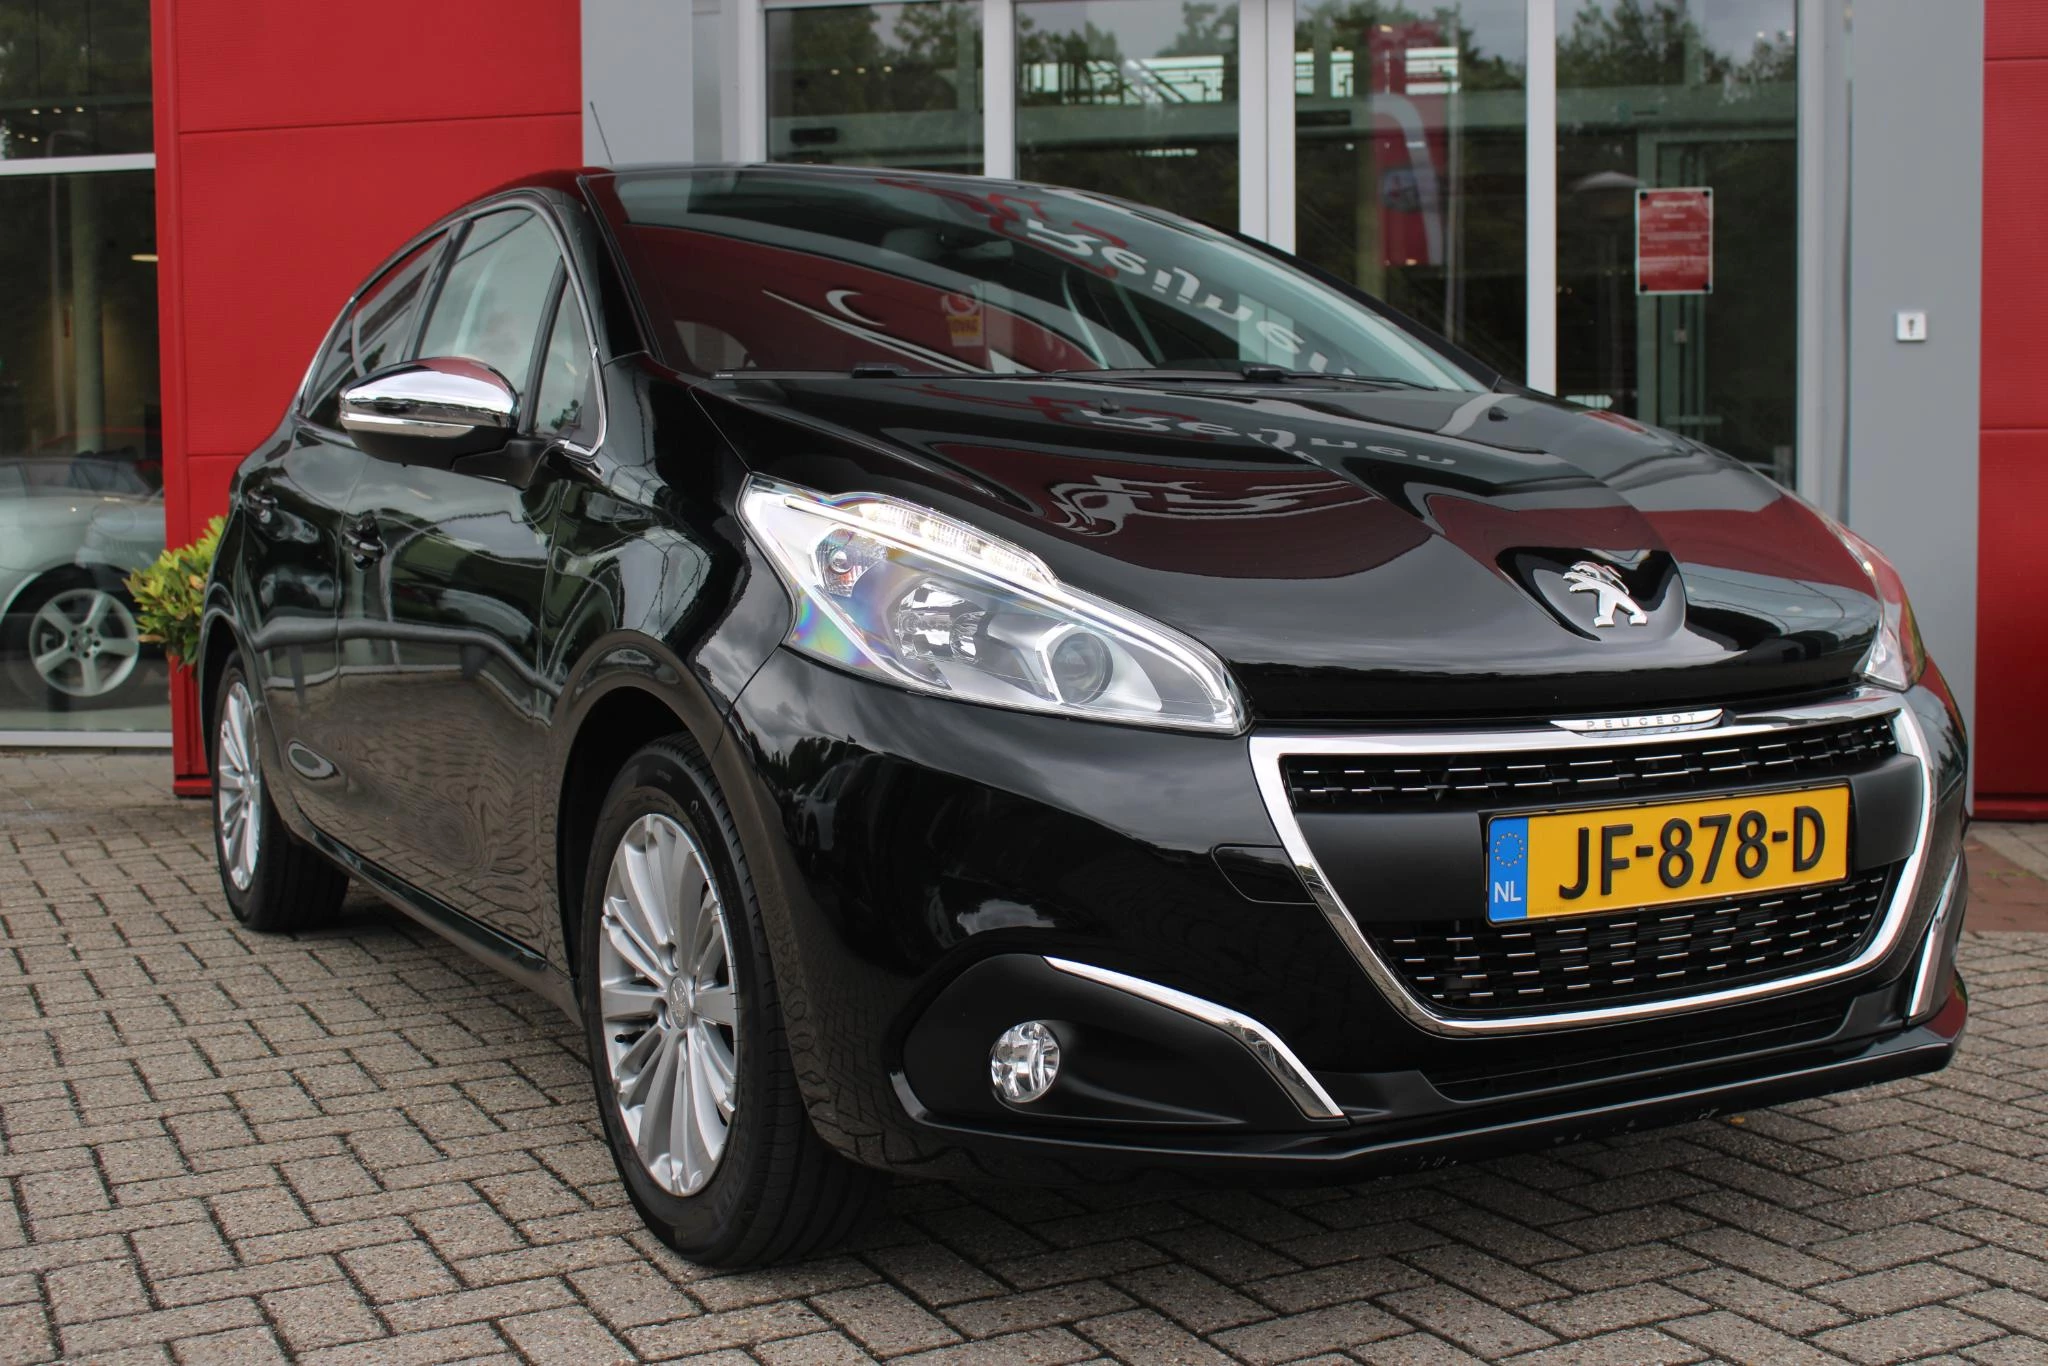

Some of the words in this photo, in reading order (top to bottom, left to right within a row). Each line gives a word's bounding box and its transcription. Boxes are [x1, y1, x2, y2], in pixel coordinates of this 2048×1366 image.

[1586, 713, 1696, 729] PEUGEOT
[1558, 806, 1826, 901] JF-878-D
[1494, 880, 1522, 904] NL
